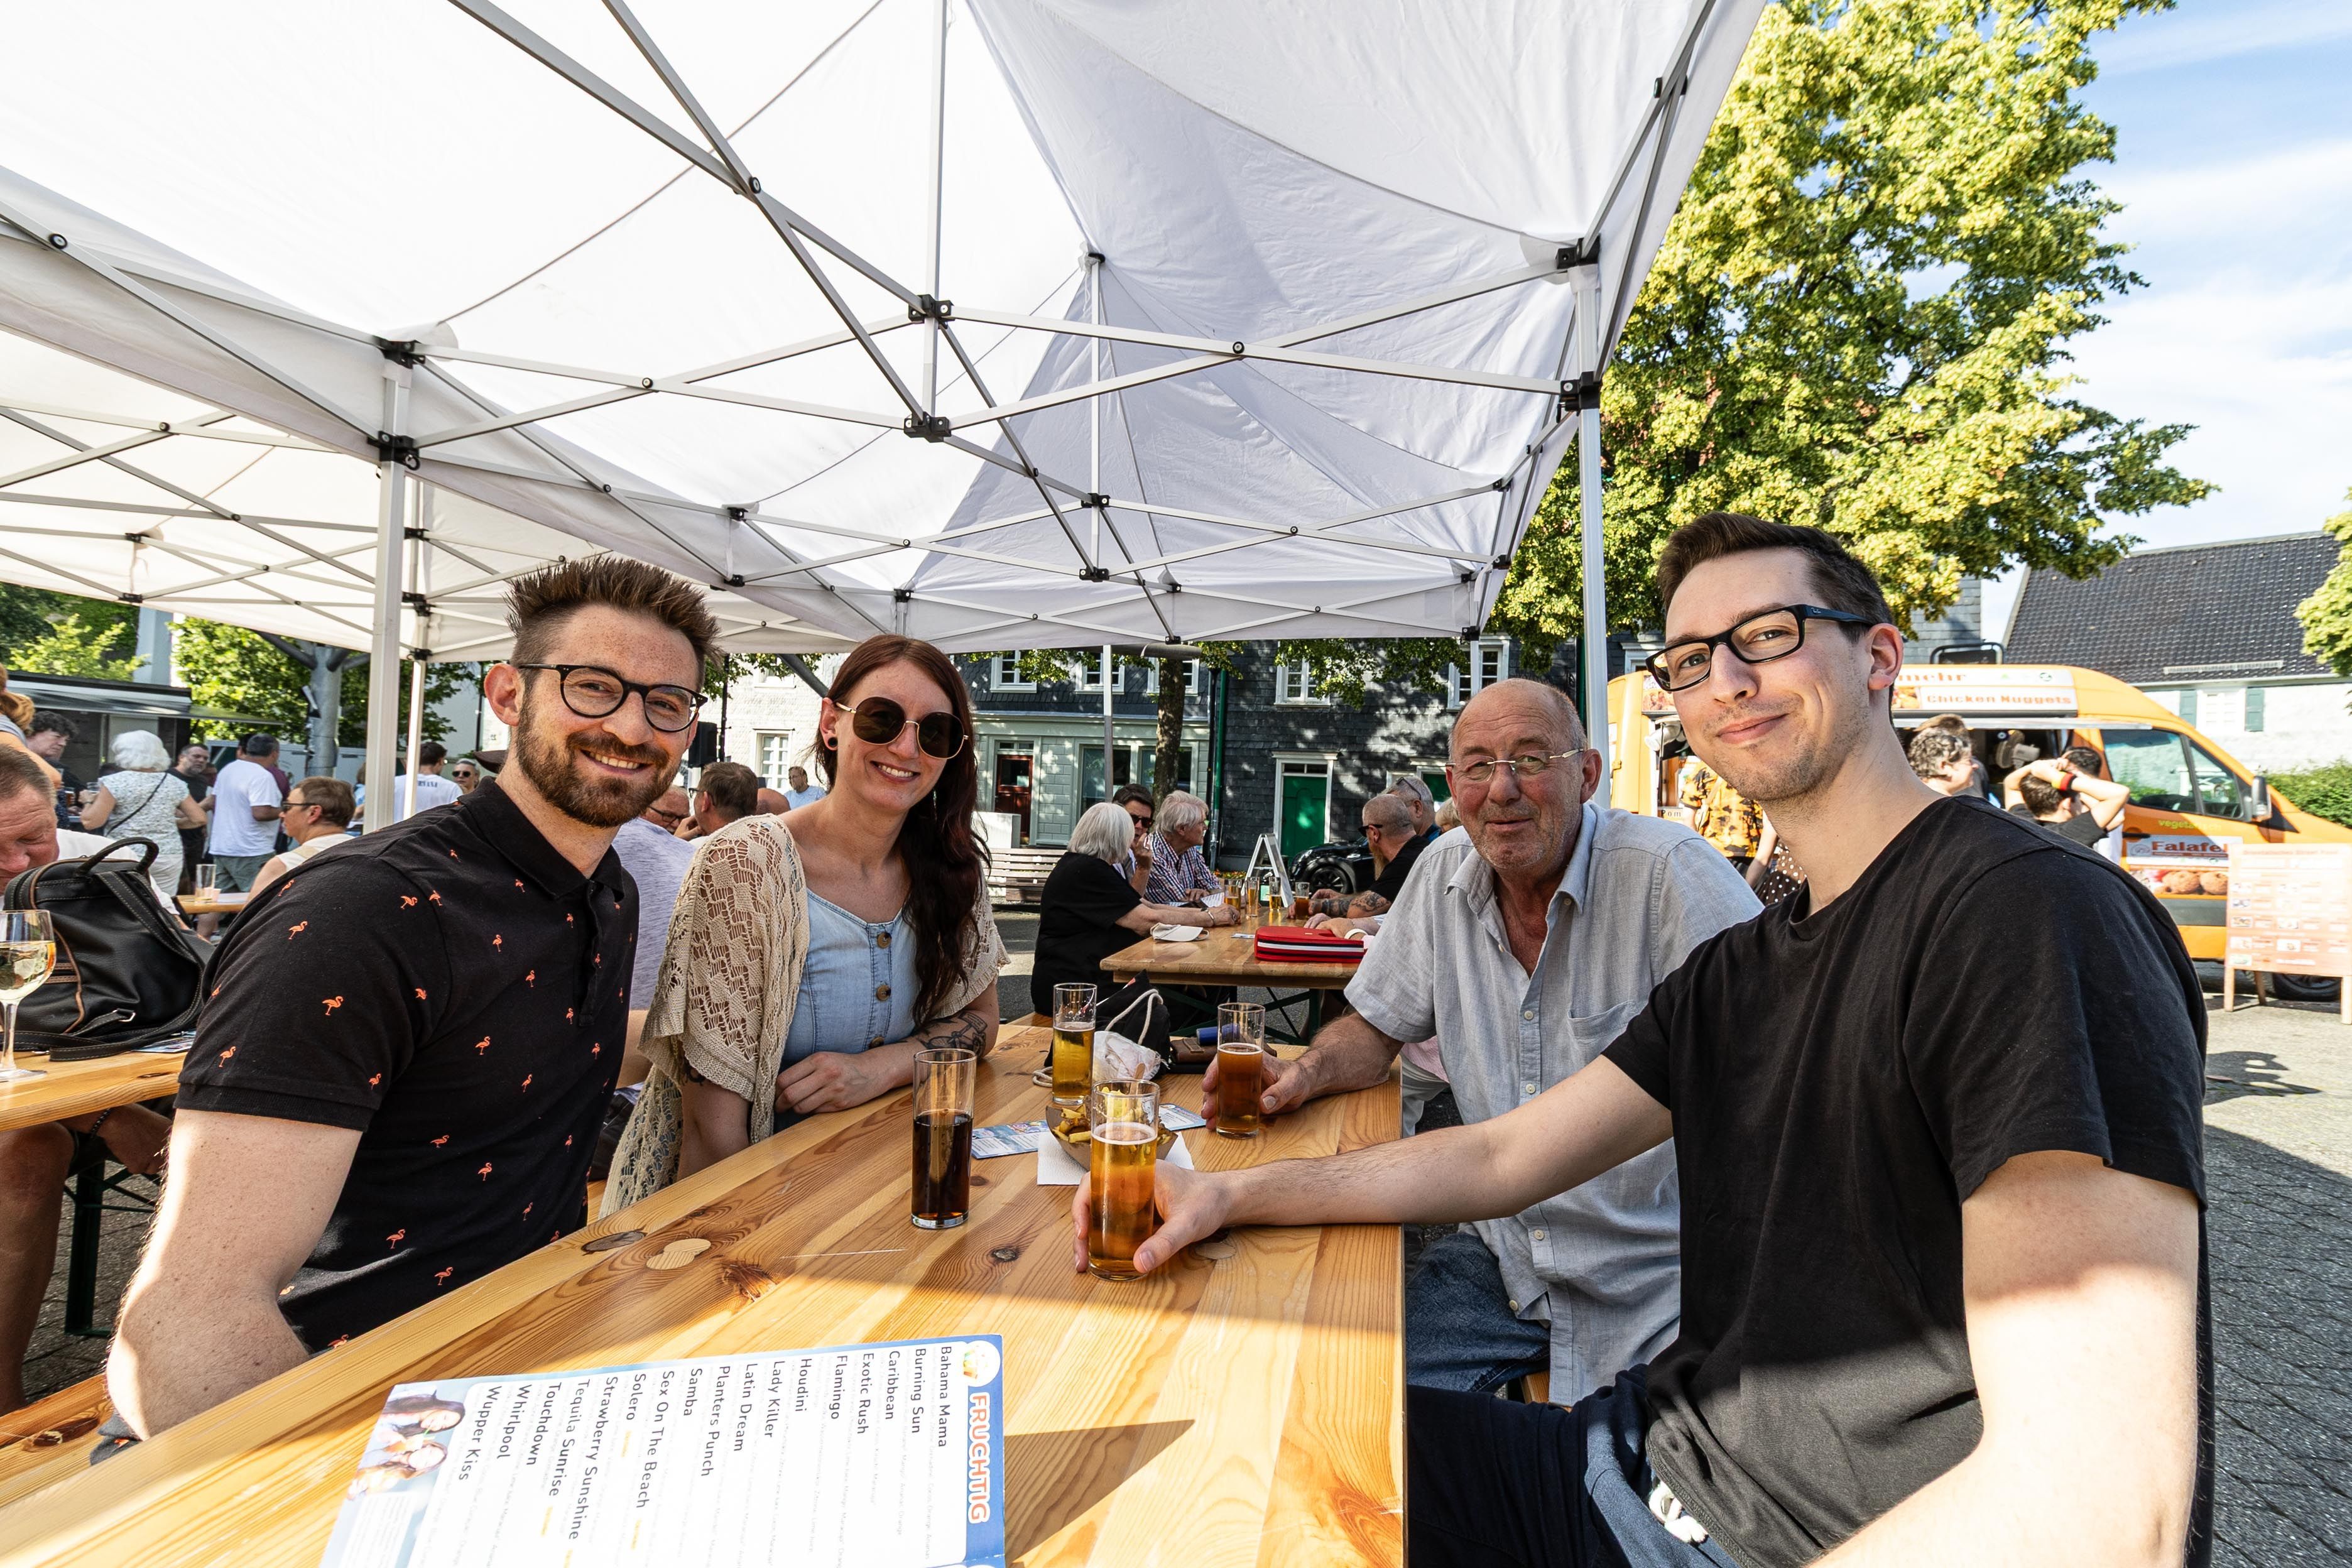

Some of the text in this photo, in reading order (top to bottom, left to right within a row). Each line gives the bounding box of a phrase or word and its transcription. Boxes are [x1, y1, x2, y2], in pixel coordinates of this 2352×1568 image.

[1927, 695, 2072, 705] Chicken Nuggets
[2152, 841, 2228, 852] Falafel
[626, 1373, 648, 1421] Solero
[658, 1370, 676, 1396] Sex
[683, 1368, 704, 1417] Samba
[709, 1365, 732, 1426] Planters
[741, 1363, 760, 1399] Latin
[767, 1360, 787, 1393] Lady
[795, 1358, 814, 1412] Houdini
[828, 1355, 849, 1420] Flamingo
[856, 1353, 876, 1434] Exotic Rush
[885, 1350, 901, 1420] Caribbean
[910, 1348, 928, 1434] Burning Sun
[937, 1346, 953, 1447] Bahama Mama
[471, 1385, 503, 1444] Wupper
[496, 1384, 533, 1459] Whirlpool
[526, 1381, 563, 1466] Touchdown
[565, 1378, 592, 1433] Tequila
[585, 1376, 619, 1461] Strawberry
[653, 1401, 670, 1423] On
[733, 1403, 753, 1452] Dream
[764, 1398, 781, 1438] Killer
[458, 1449, 482, 1481] Kiss
[548, 1438, 576, 1496] Sunrise
[646, 1426, 666, 1456] The
[700, 1430, 721, 1477] Punch
[971, 1394, 988, 1521] FRUCHTIG
[569, 1466, 599, 1540] Sunshine
[636, 1461, 658, 1508] Beach
